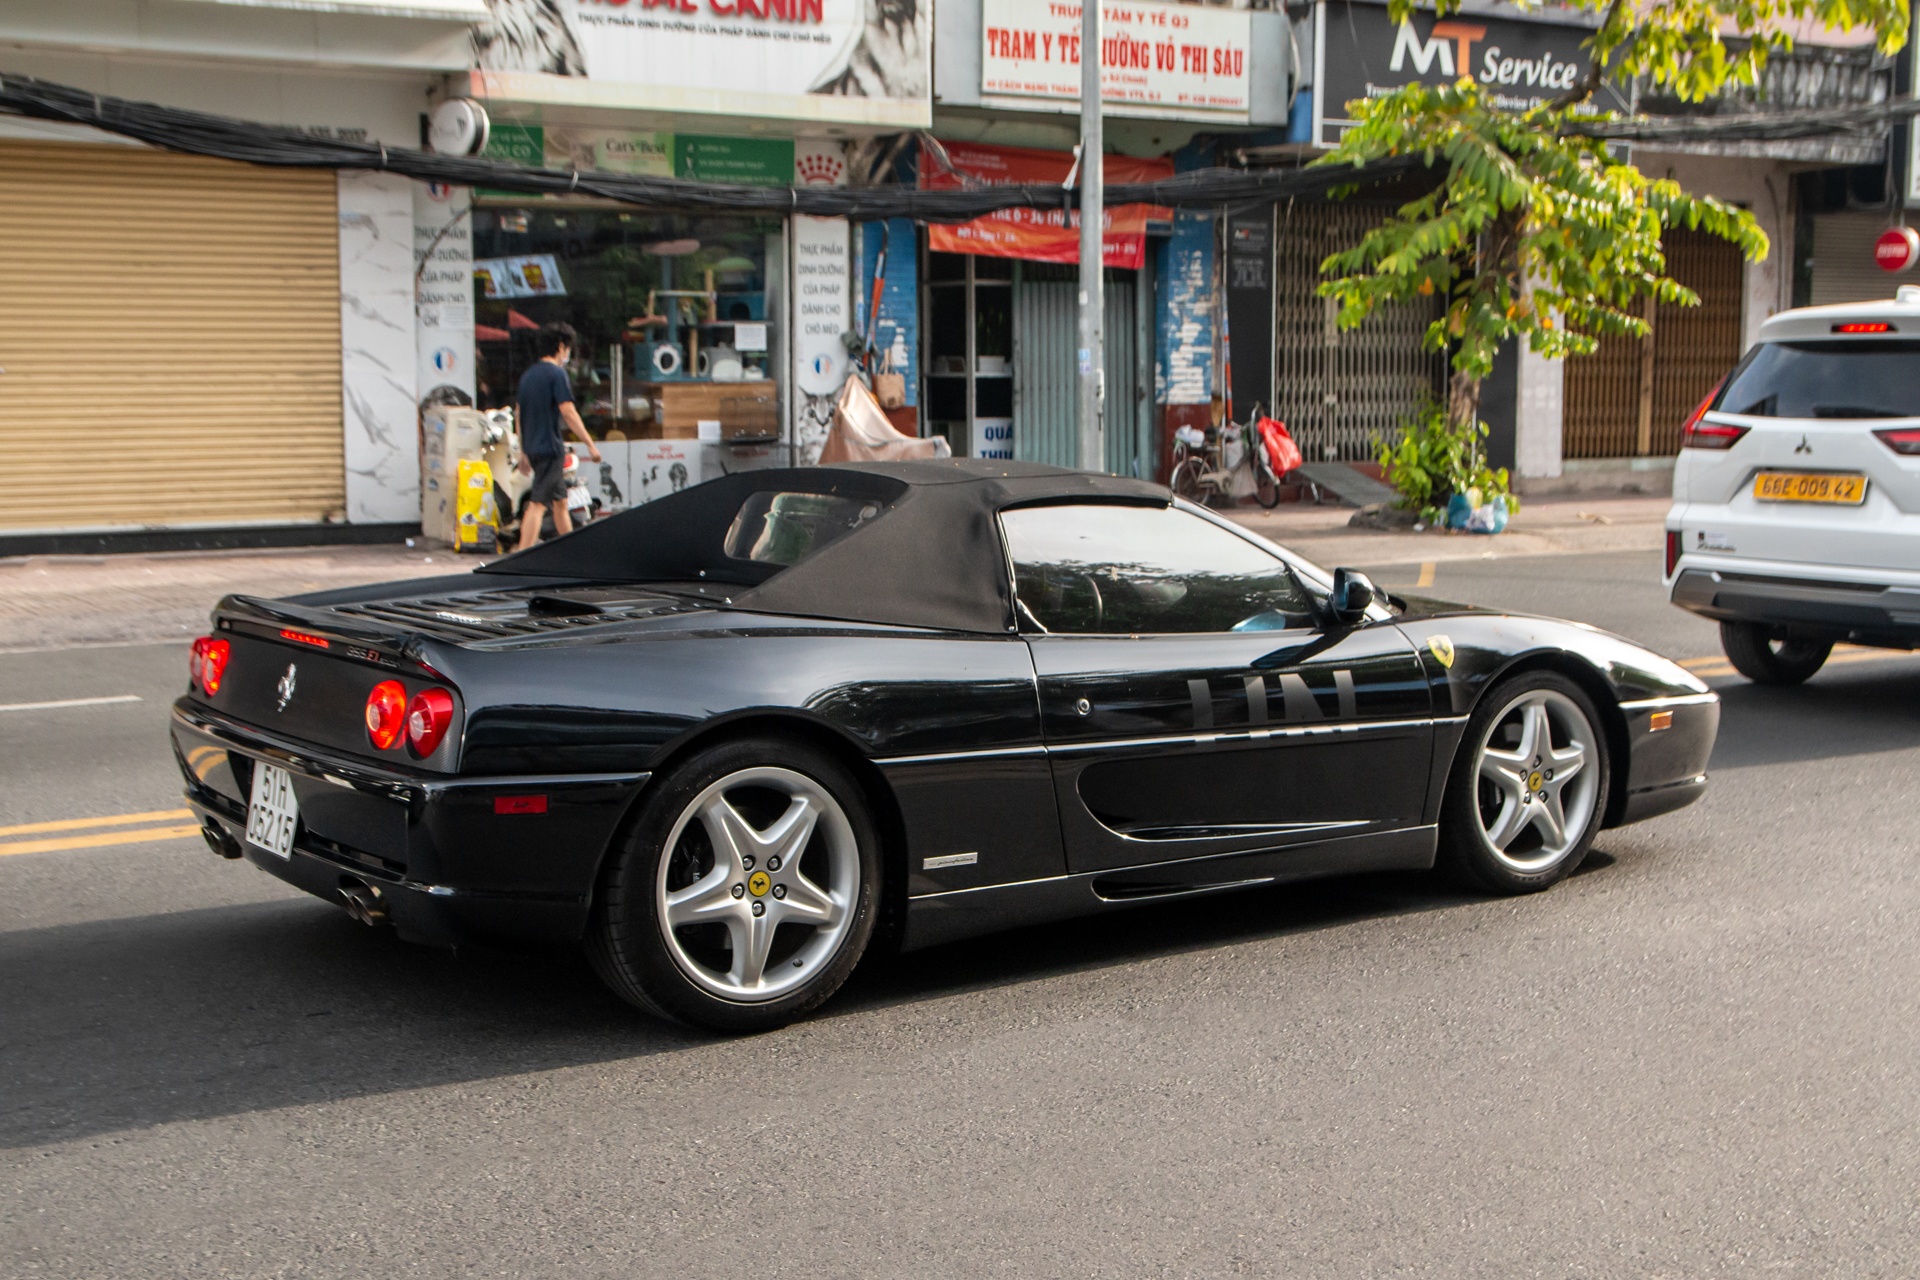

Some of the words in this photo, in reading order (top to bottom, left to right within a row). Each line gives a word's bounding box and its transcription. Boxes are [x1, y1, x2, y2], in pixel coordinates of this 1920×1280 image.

[1137, 12, 1144, 24] Y
[1171, 15, 1188, 29] Q3
[987, 28, 1036, 68] TRẠM
[1043, 33, 1052, 62] Y
[1058, 23, 1080, 64] TẾ
[1156, 35, 1175, 71] VÕ
[1181, 45, 1208, 83] THỊ
[1213, 40, 1243, 77] SÁU
[1389, 19, 1487, 77] MT
[1480, 46, 1578, 90] Service
[263, 765, 288, 810] 51H
